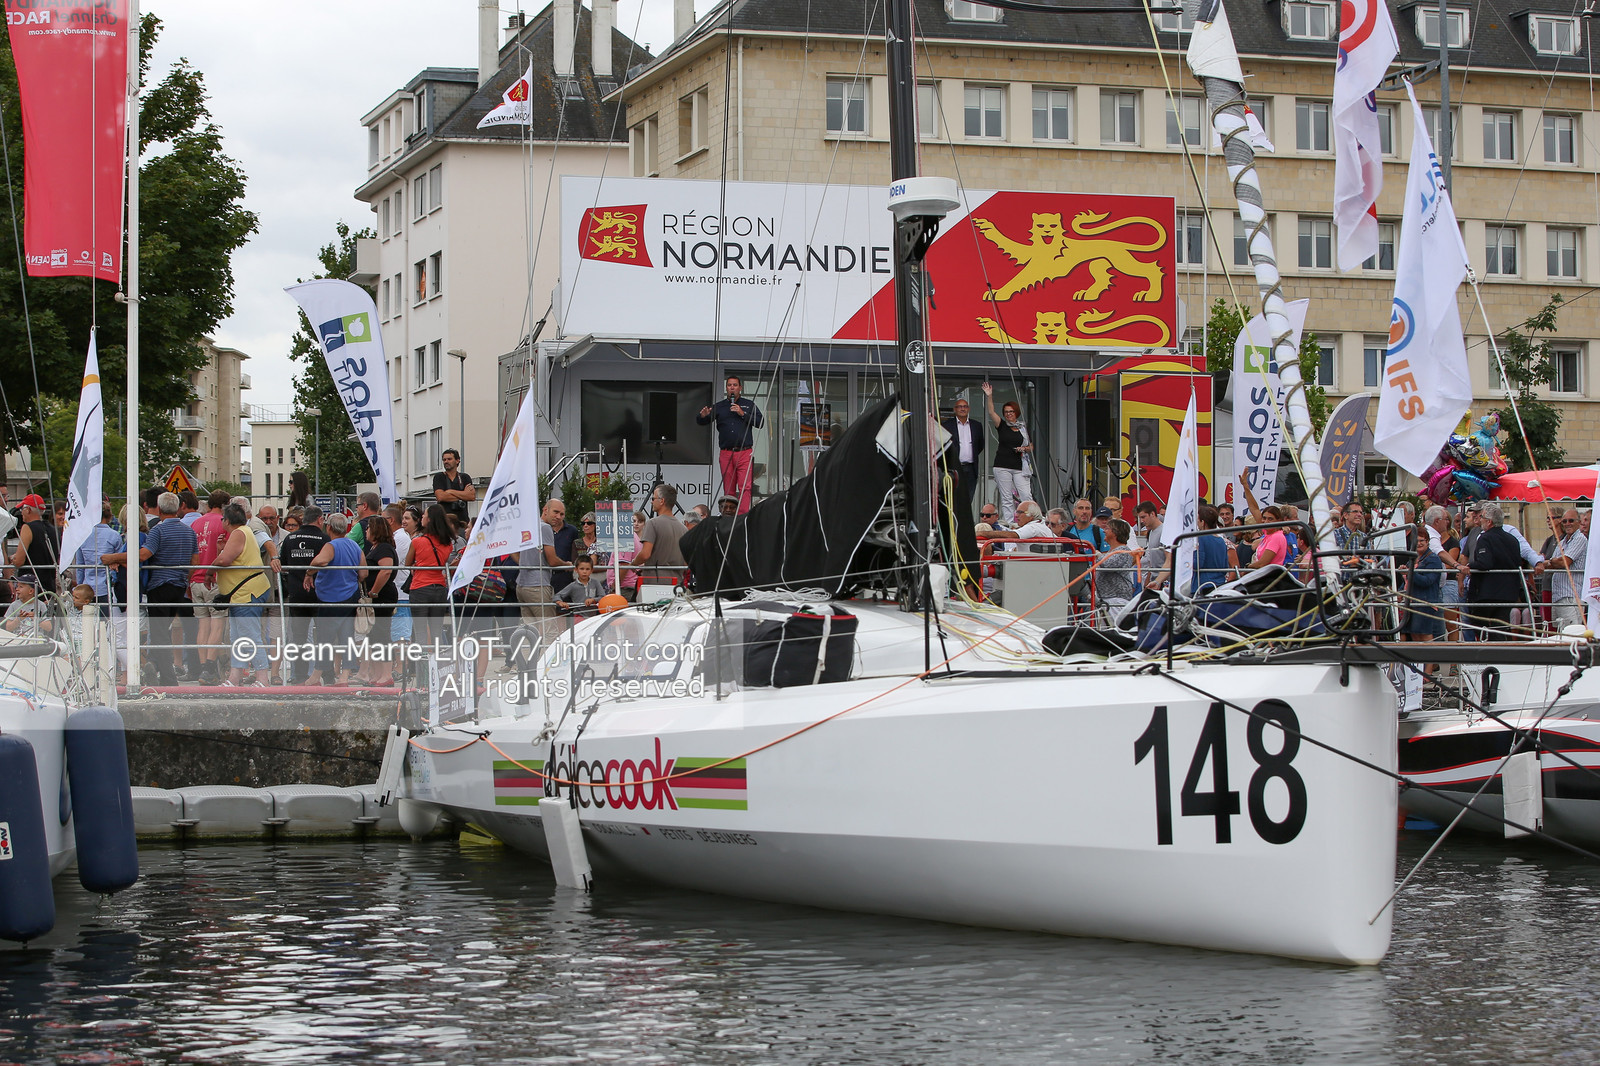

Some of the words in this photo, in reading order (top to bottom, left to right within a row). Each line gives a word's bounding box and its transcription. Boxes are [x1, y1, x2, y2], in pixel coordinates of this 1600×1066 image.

[890, 184, 906, 198] DEN
[662, 209, 774, 237] RÉGION
[663, 241, 890, 273] NORMANDIE
[664, 272, 782, 286] www.normandie.fr
[1387, 358, 1425, 421] IFS
[1260, 387, 1285, 507] ARTEMET
[629, 483, 711, 495] ORNDIE
[596, 513, 628, 522] actuité
[605, 522, 634, 535] dssi
[1133, 698, 1308, 845] 148
[659, 828, 694, 841] PETITS
[697, 830, 758, 846] DÉJEUNERS
